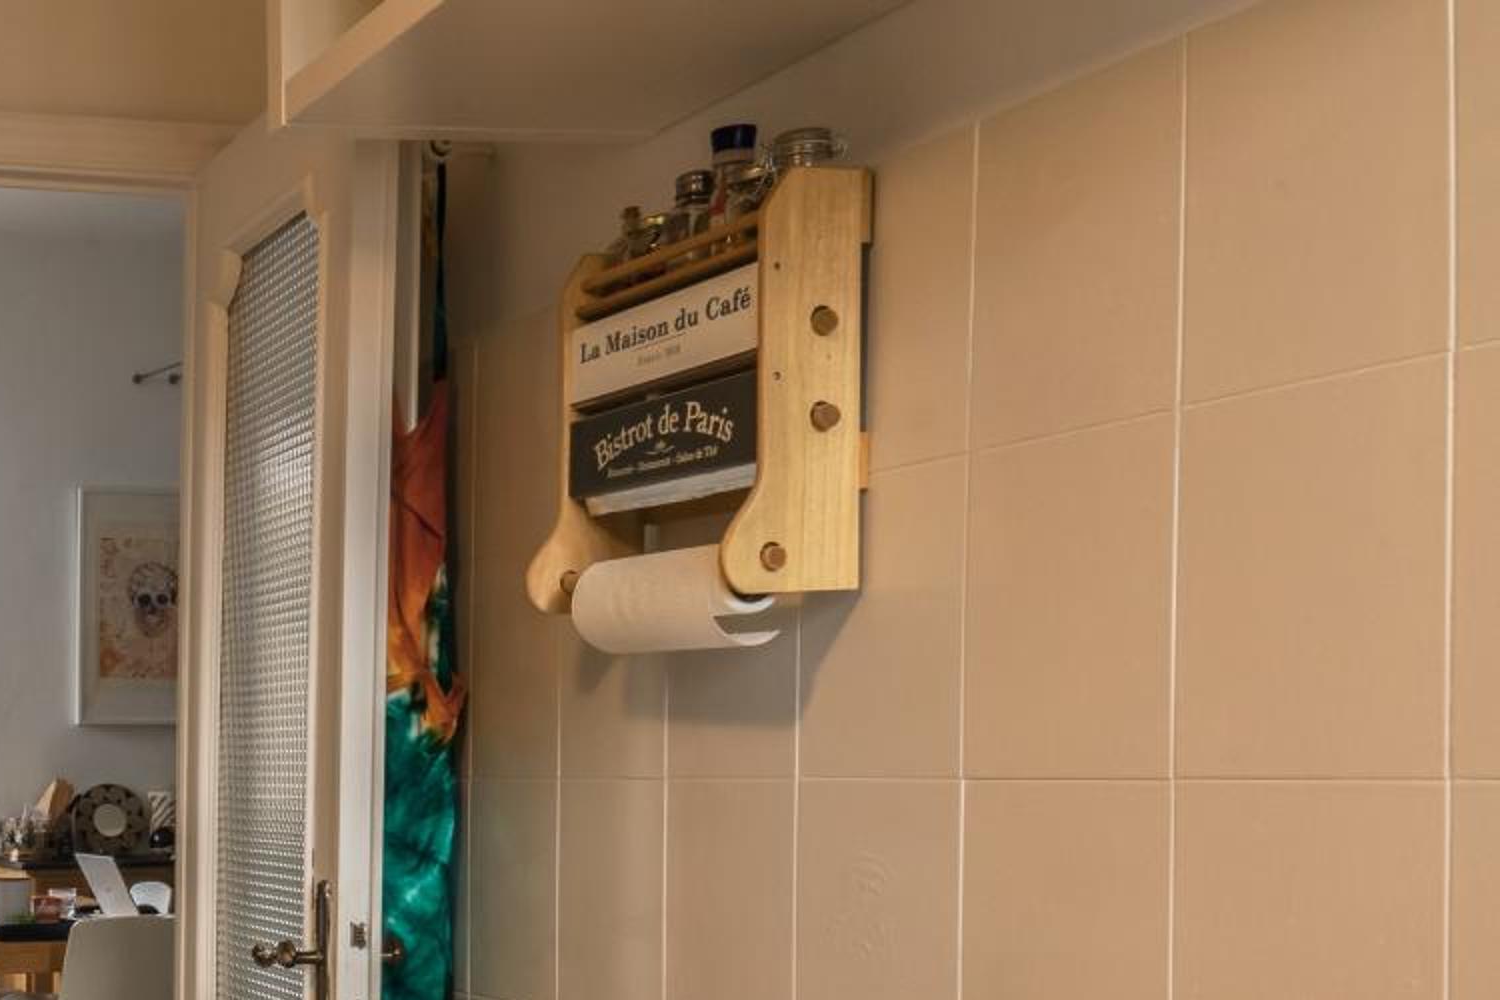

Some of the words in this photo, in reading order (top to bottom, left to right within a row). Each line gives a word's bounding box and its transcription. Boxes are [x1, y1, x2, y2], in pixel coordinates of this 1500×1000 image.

[580, 341, 601, 364] La
[605, 322, 670, 355] Maison
[674, 307, 699, 332] du
[705, 287, 751, 321] Café
[593, 413, 654, 471] Bistrot
[658, 403, 680, 435] de
[683, 401, 734, 443] Paris
